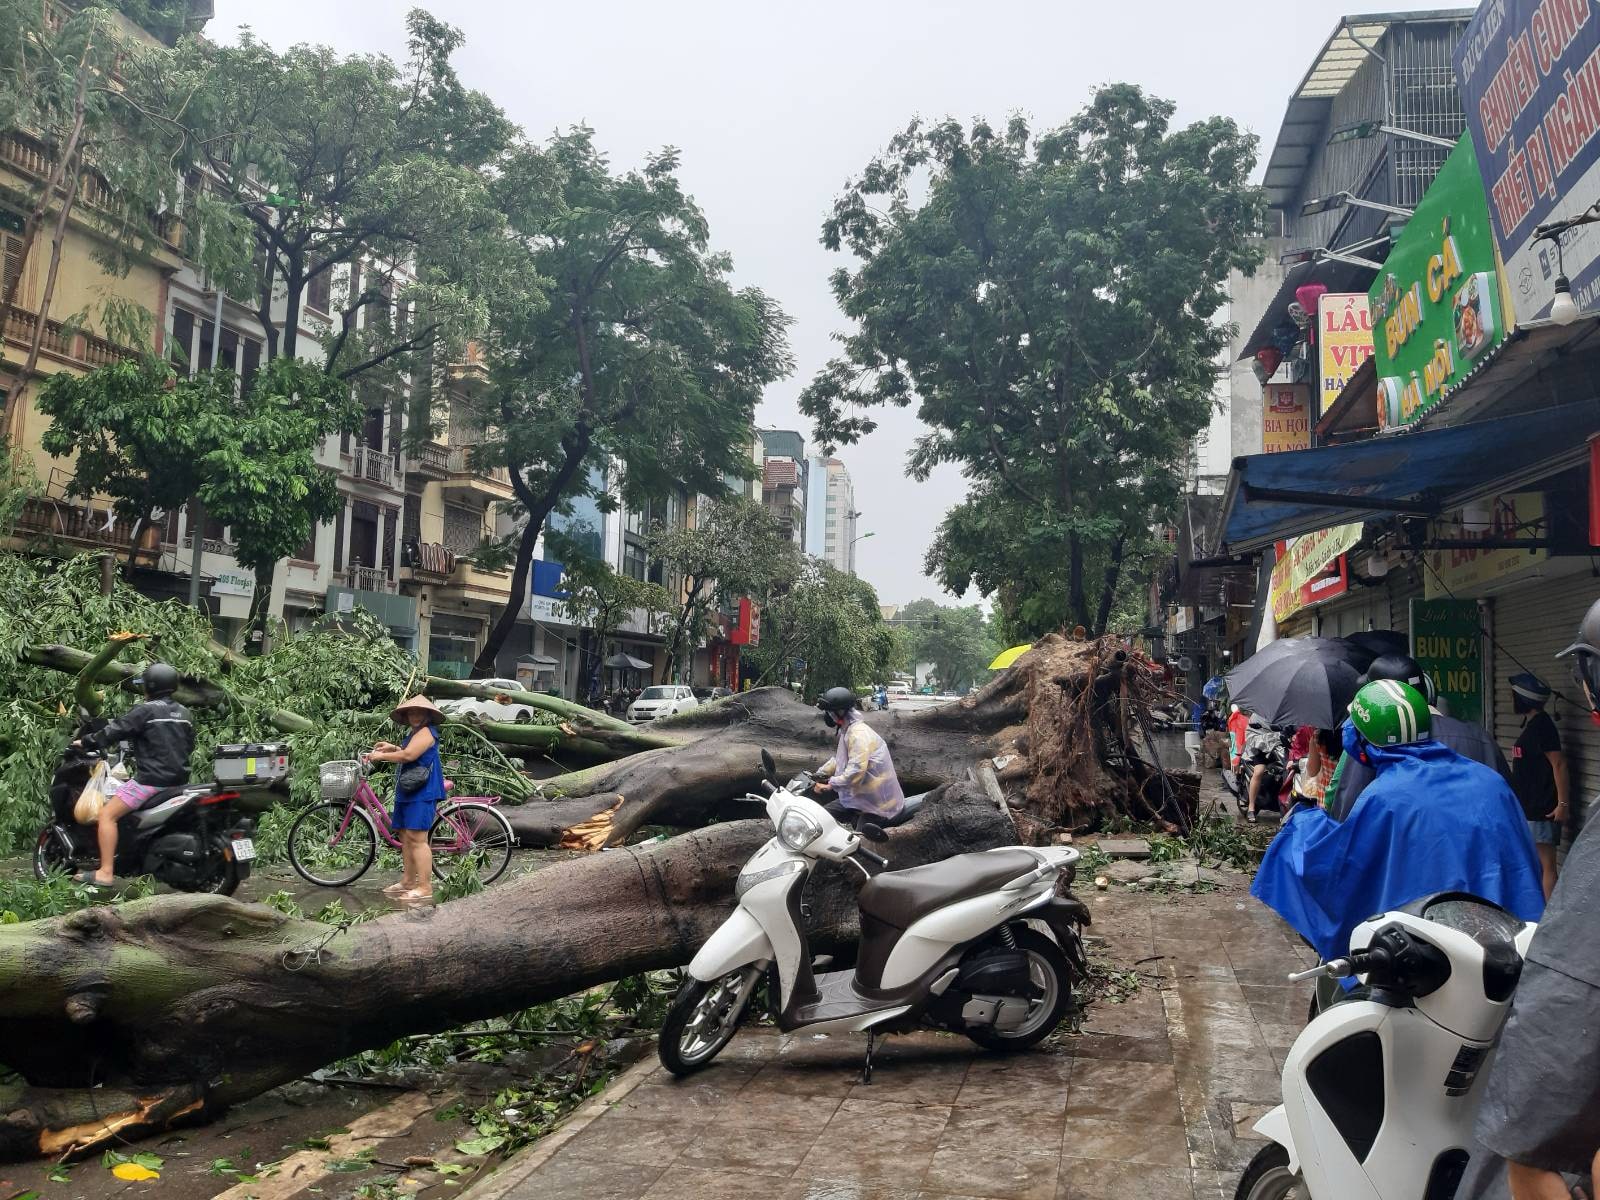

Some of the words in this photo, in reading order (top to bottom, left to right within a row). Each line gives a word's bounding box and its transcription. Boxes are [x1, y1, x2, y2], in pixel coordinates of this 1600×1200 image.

[1480, 27, 1540, 154] CHUYÊN
[1491, 135, 1535, 240] THIẾT
[1525, 124, 1557, 201] BỊ
[1385, 280, 1423, 360] BÚN
[1427, 214, 1463, 304] CÁ
[1265, 418, 1283, 433] BIA
[1416, 632, 1451, 658] BÚN
[1456, 632, 1479, 659] CÁ
[1447, 665, 1477, 698] NỘI
